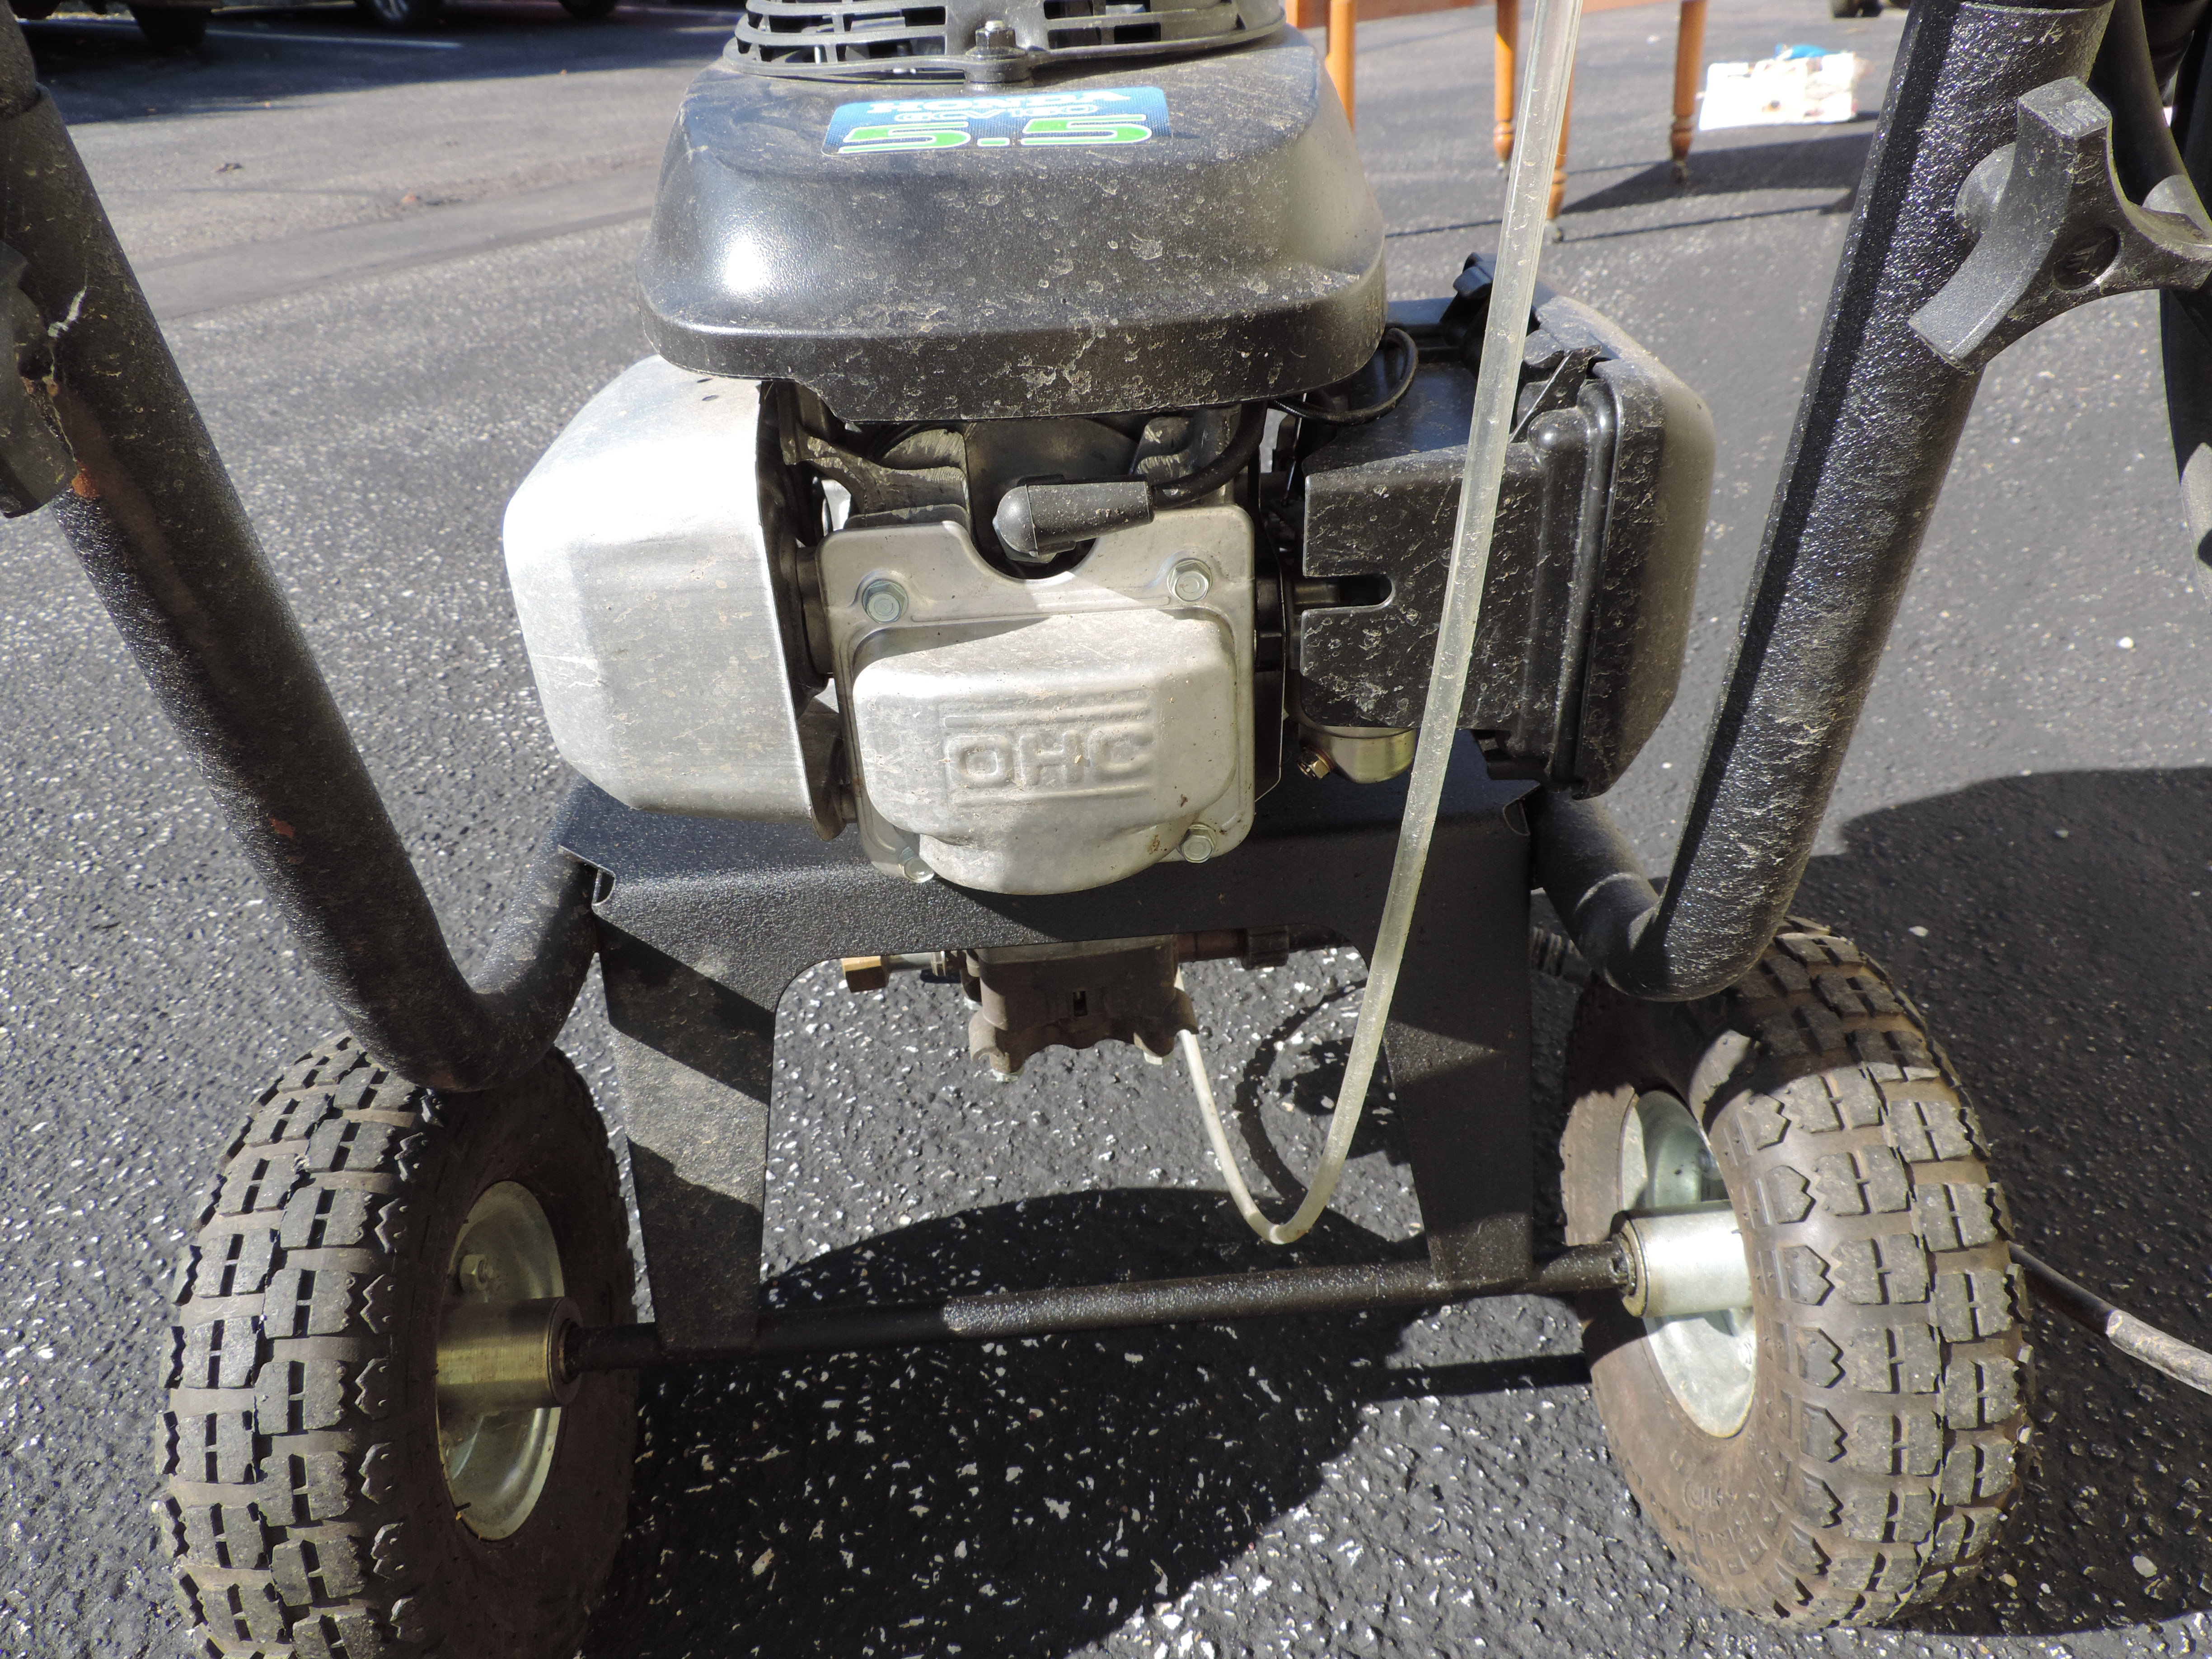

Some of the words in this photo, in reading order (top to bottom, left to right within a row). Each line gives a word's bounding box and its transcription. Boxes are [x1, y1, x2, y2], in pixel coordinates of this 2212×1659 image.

[867, 91, 1131, 113] HONDA
[894, 104, 1099, 122] GCV160
[839, 114, 1153, 154] 5.5
[947, 722, 1155, 788] OHC
